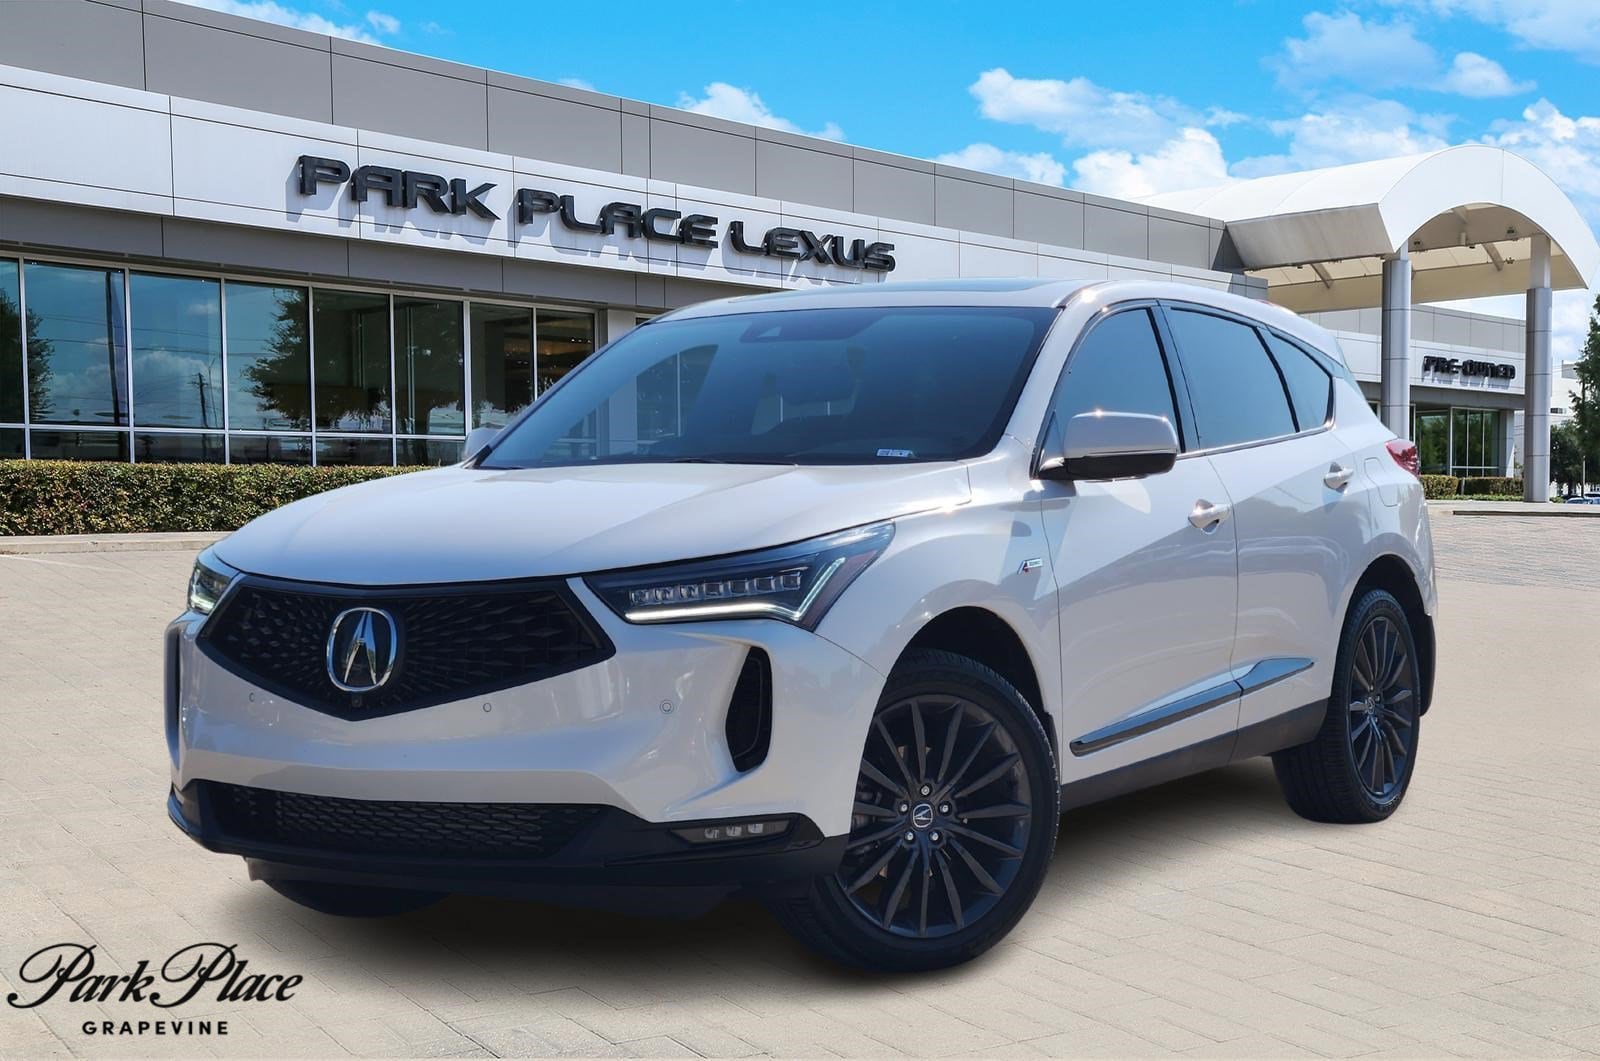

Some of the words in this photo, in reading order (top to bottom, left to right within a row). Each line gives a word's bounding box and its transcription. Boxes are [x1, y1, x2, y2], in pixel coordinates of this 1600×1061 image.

[298, 154, 500, 221] PARK
[517, 187, 718, 249] PLACE
[731, 220, 896, 271] LEXUS
[1423, 355, 1516, 379] PRE-OWNED
